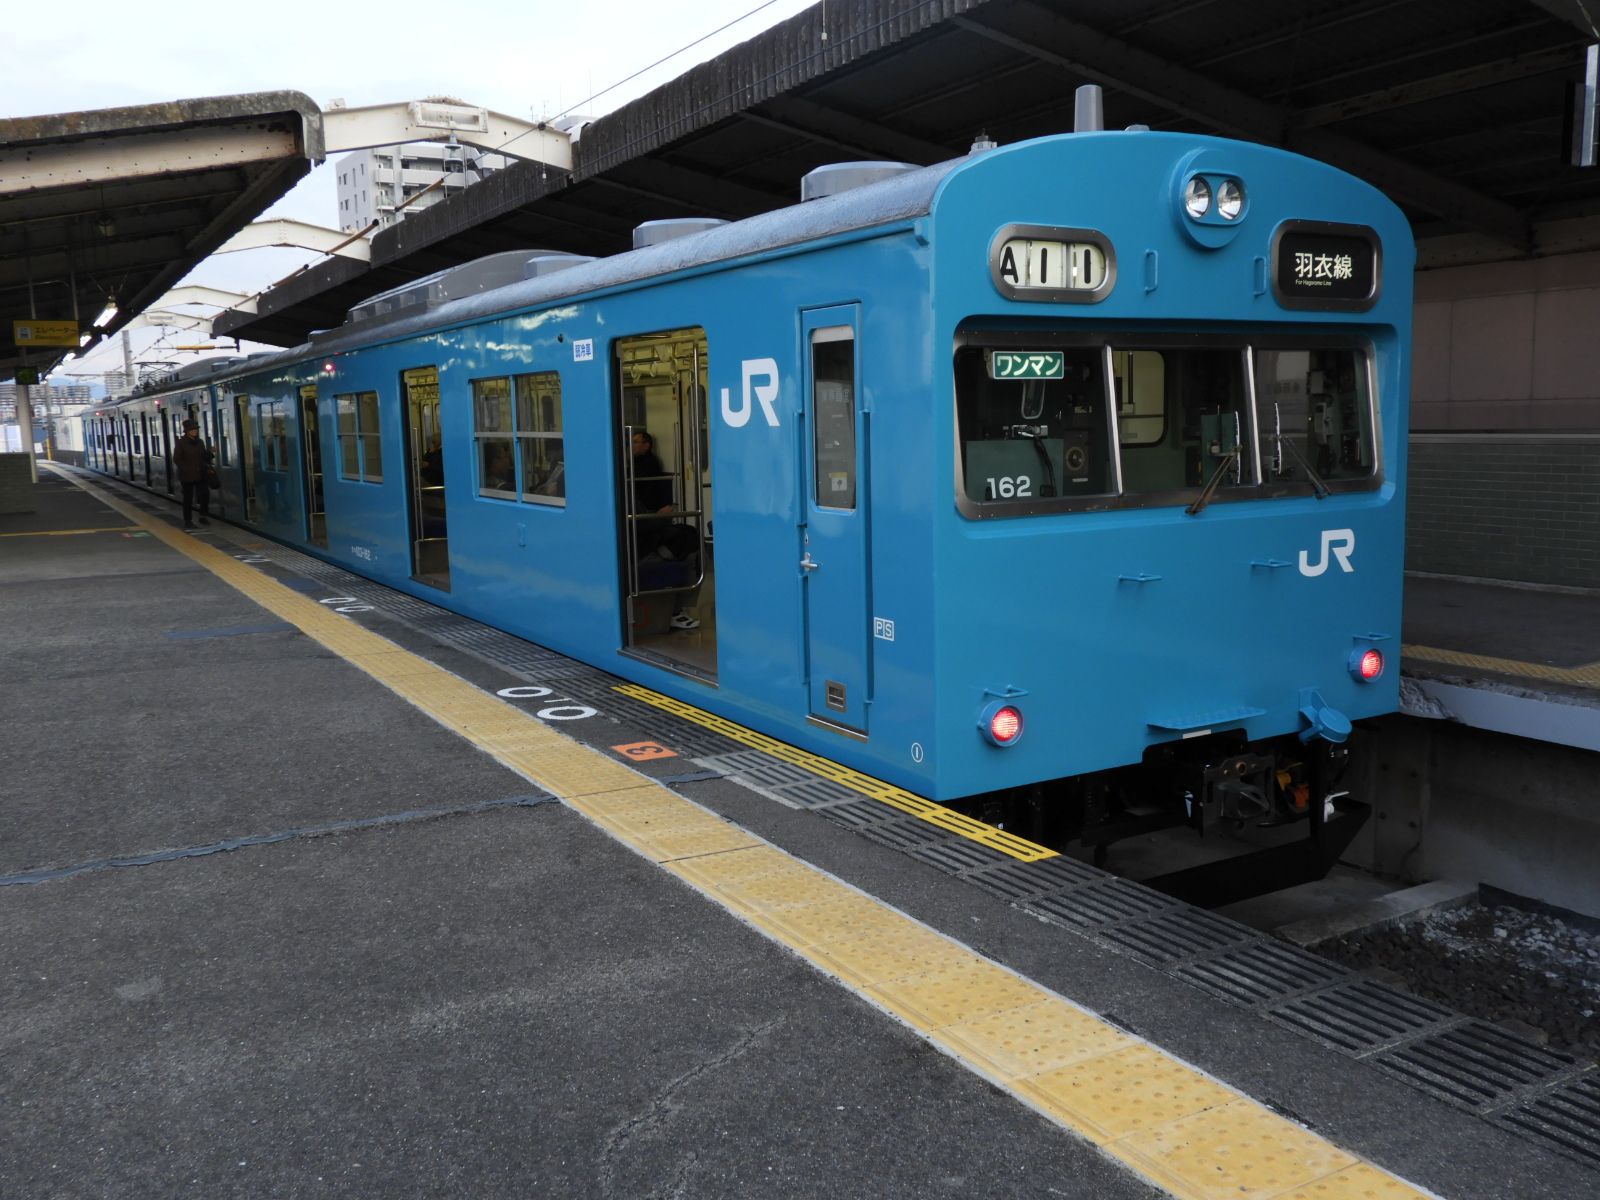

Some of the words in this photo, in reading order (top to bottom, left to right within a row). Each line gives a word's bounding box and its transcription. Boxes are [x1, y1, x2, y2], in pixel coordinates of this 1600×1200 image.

[1294, 252, 1353, 280] 羽衣線
[997, 354, 1061, 377] ワンマン
[721, 357, 781, 428] JR
[986, 475, 1032, 499] 162
[1298, 528, 1355, 577] JR
[875, 619, 893, 639] PS
[625, 745, 664, 756] 3
